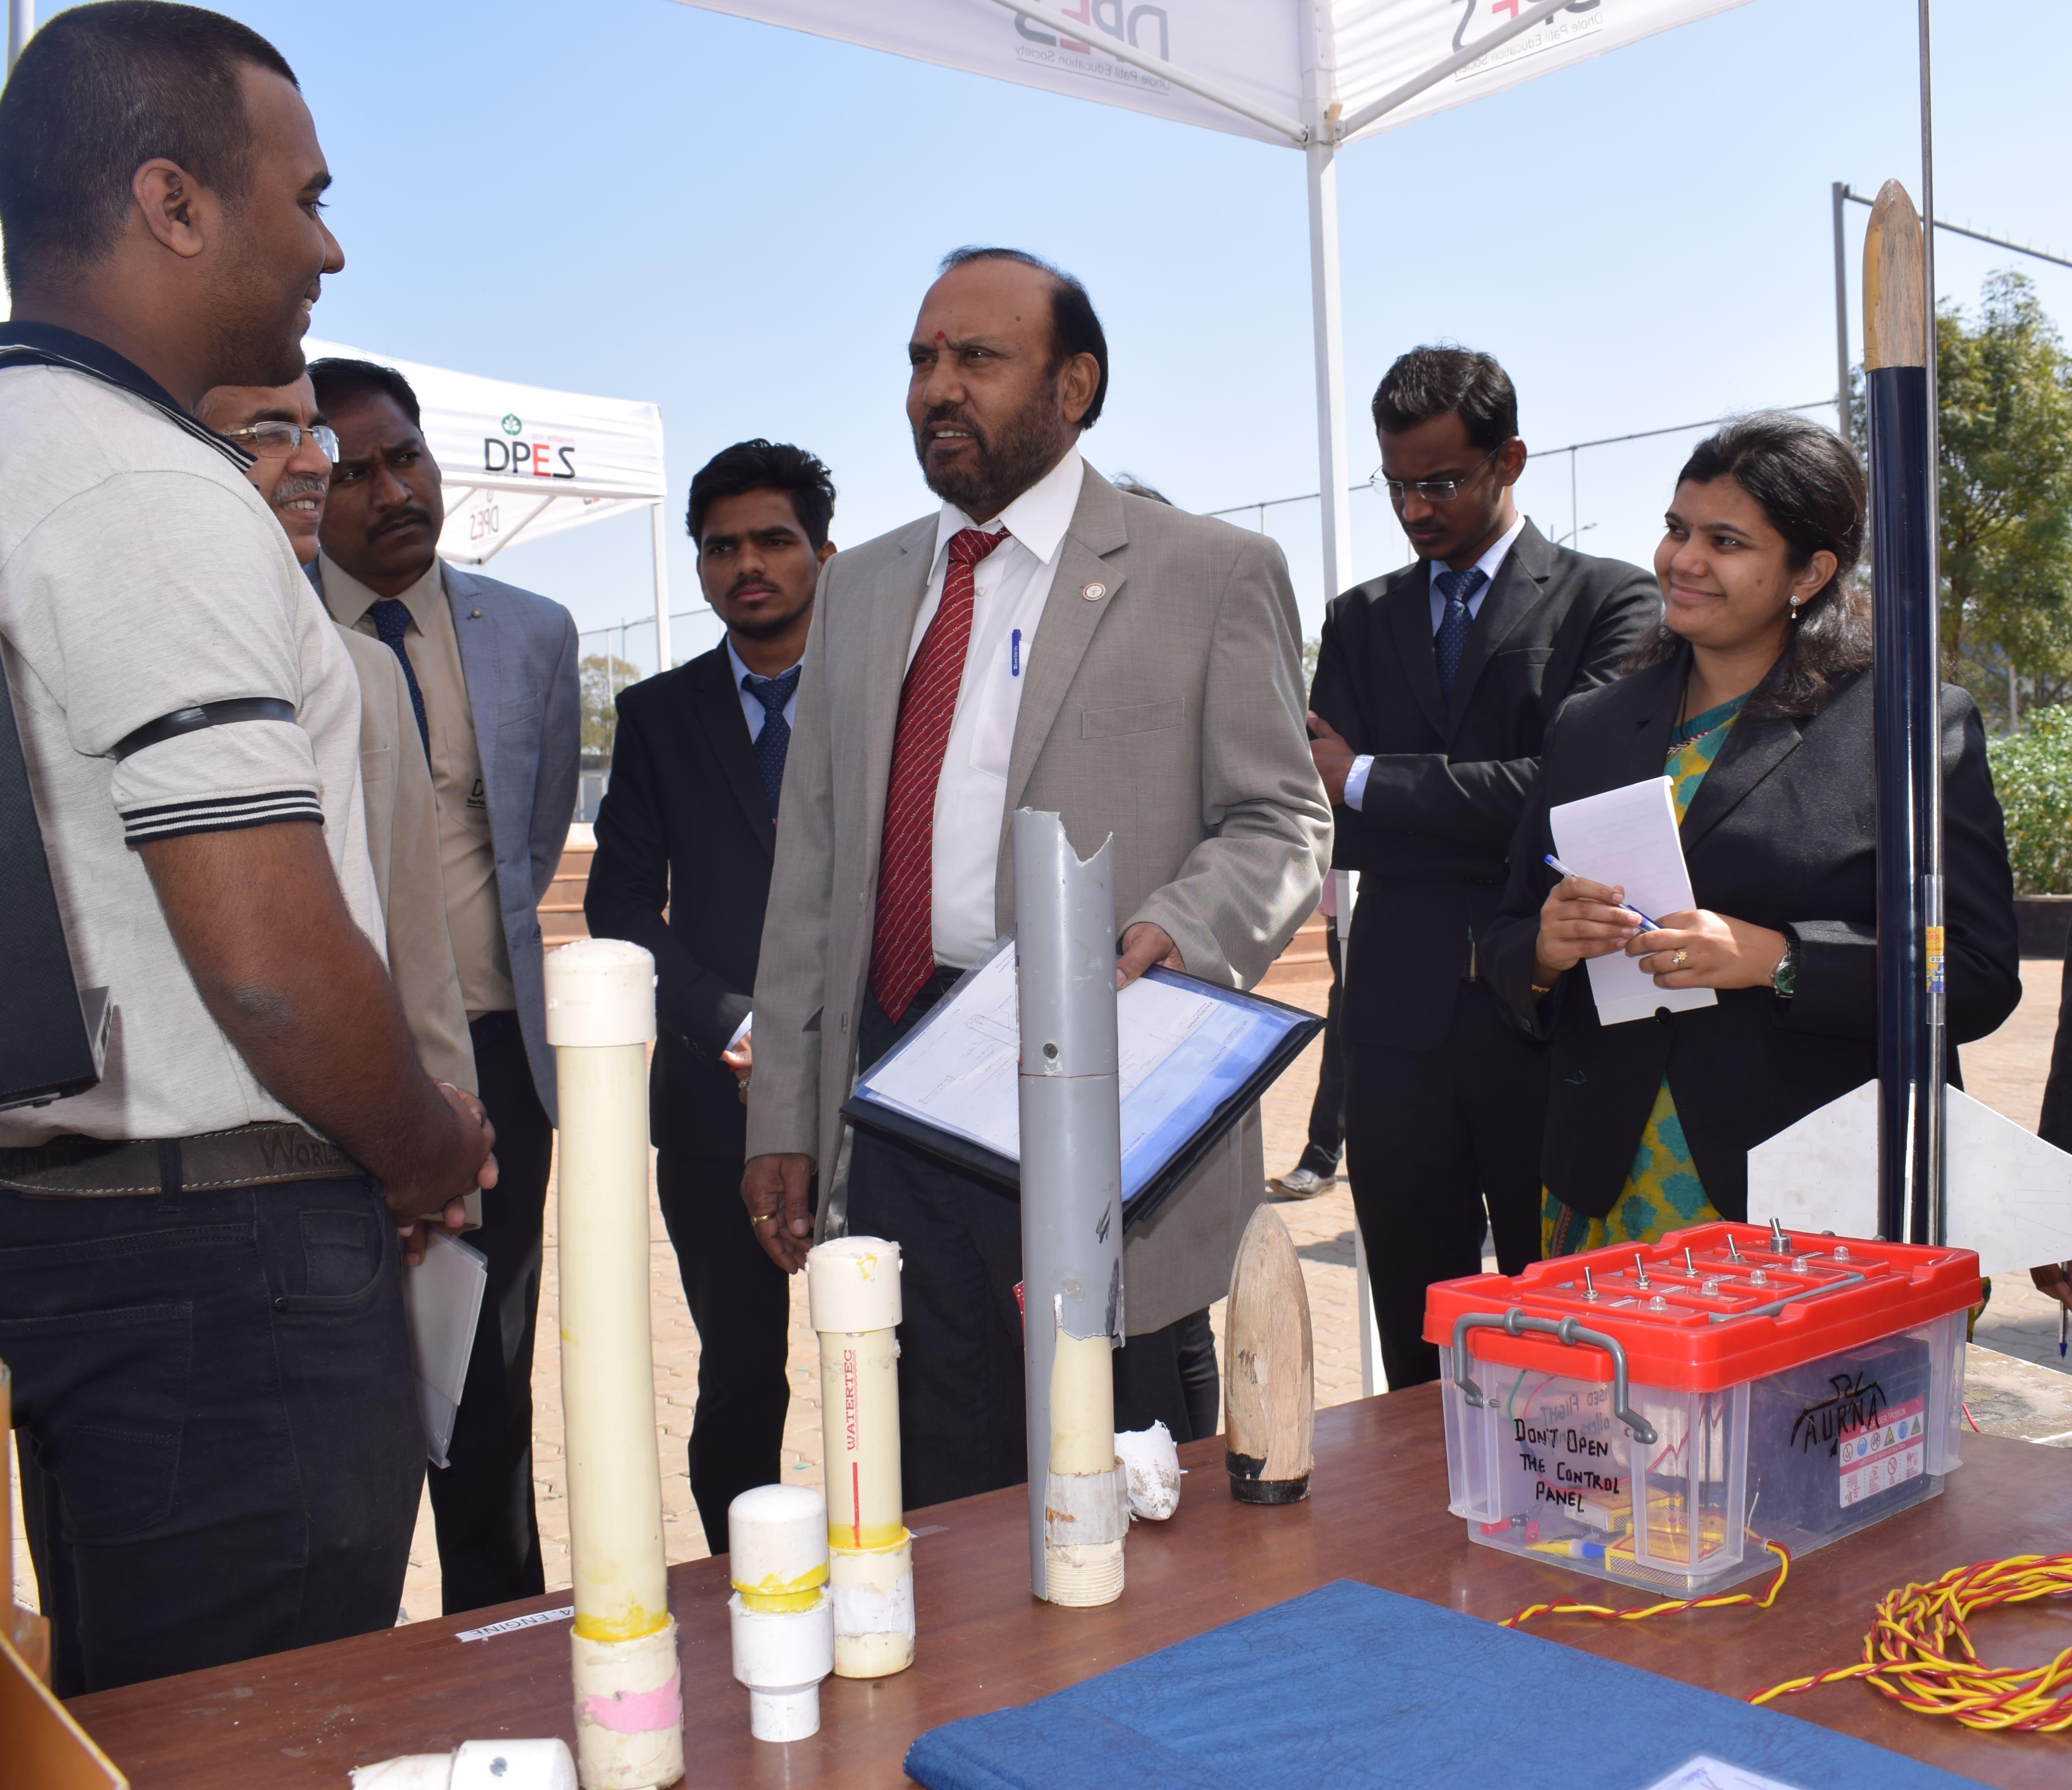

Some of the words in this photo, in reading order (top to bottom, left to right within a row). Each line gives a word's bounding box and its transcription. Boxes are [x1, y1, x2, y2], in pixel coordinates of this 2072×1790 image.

[484, 438, 575, 479] DPES
[844, 1349, 855, 1451] WATERTEC
[1514, 1418, 1558, 1449] DON'T
[1567, 1429, 1608, 1457] OPEN
[1519, 1453, 1545, 1473] THE
[1557, 1462, 1620, 1494] CONTROL
[1536, 1481, 1584, 1513] PANEL
[470, 1614, 550, 1636] ENGINE
